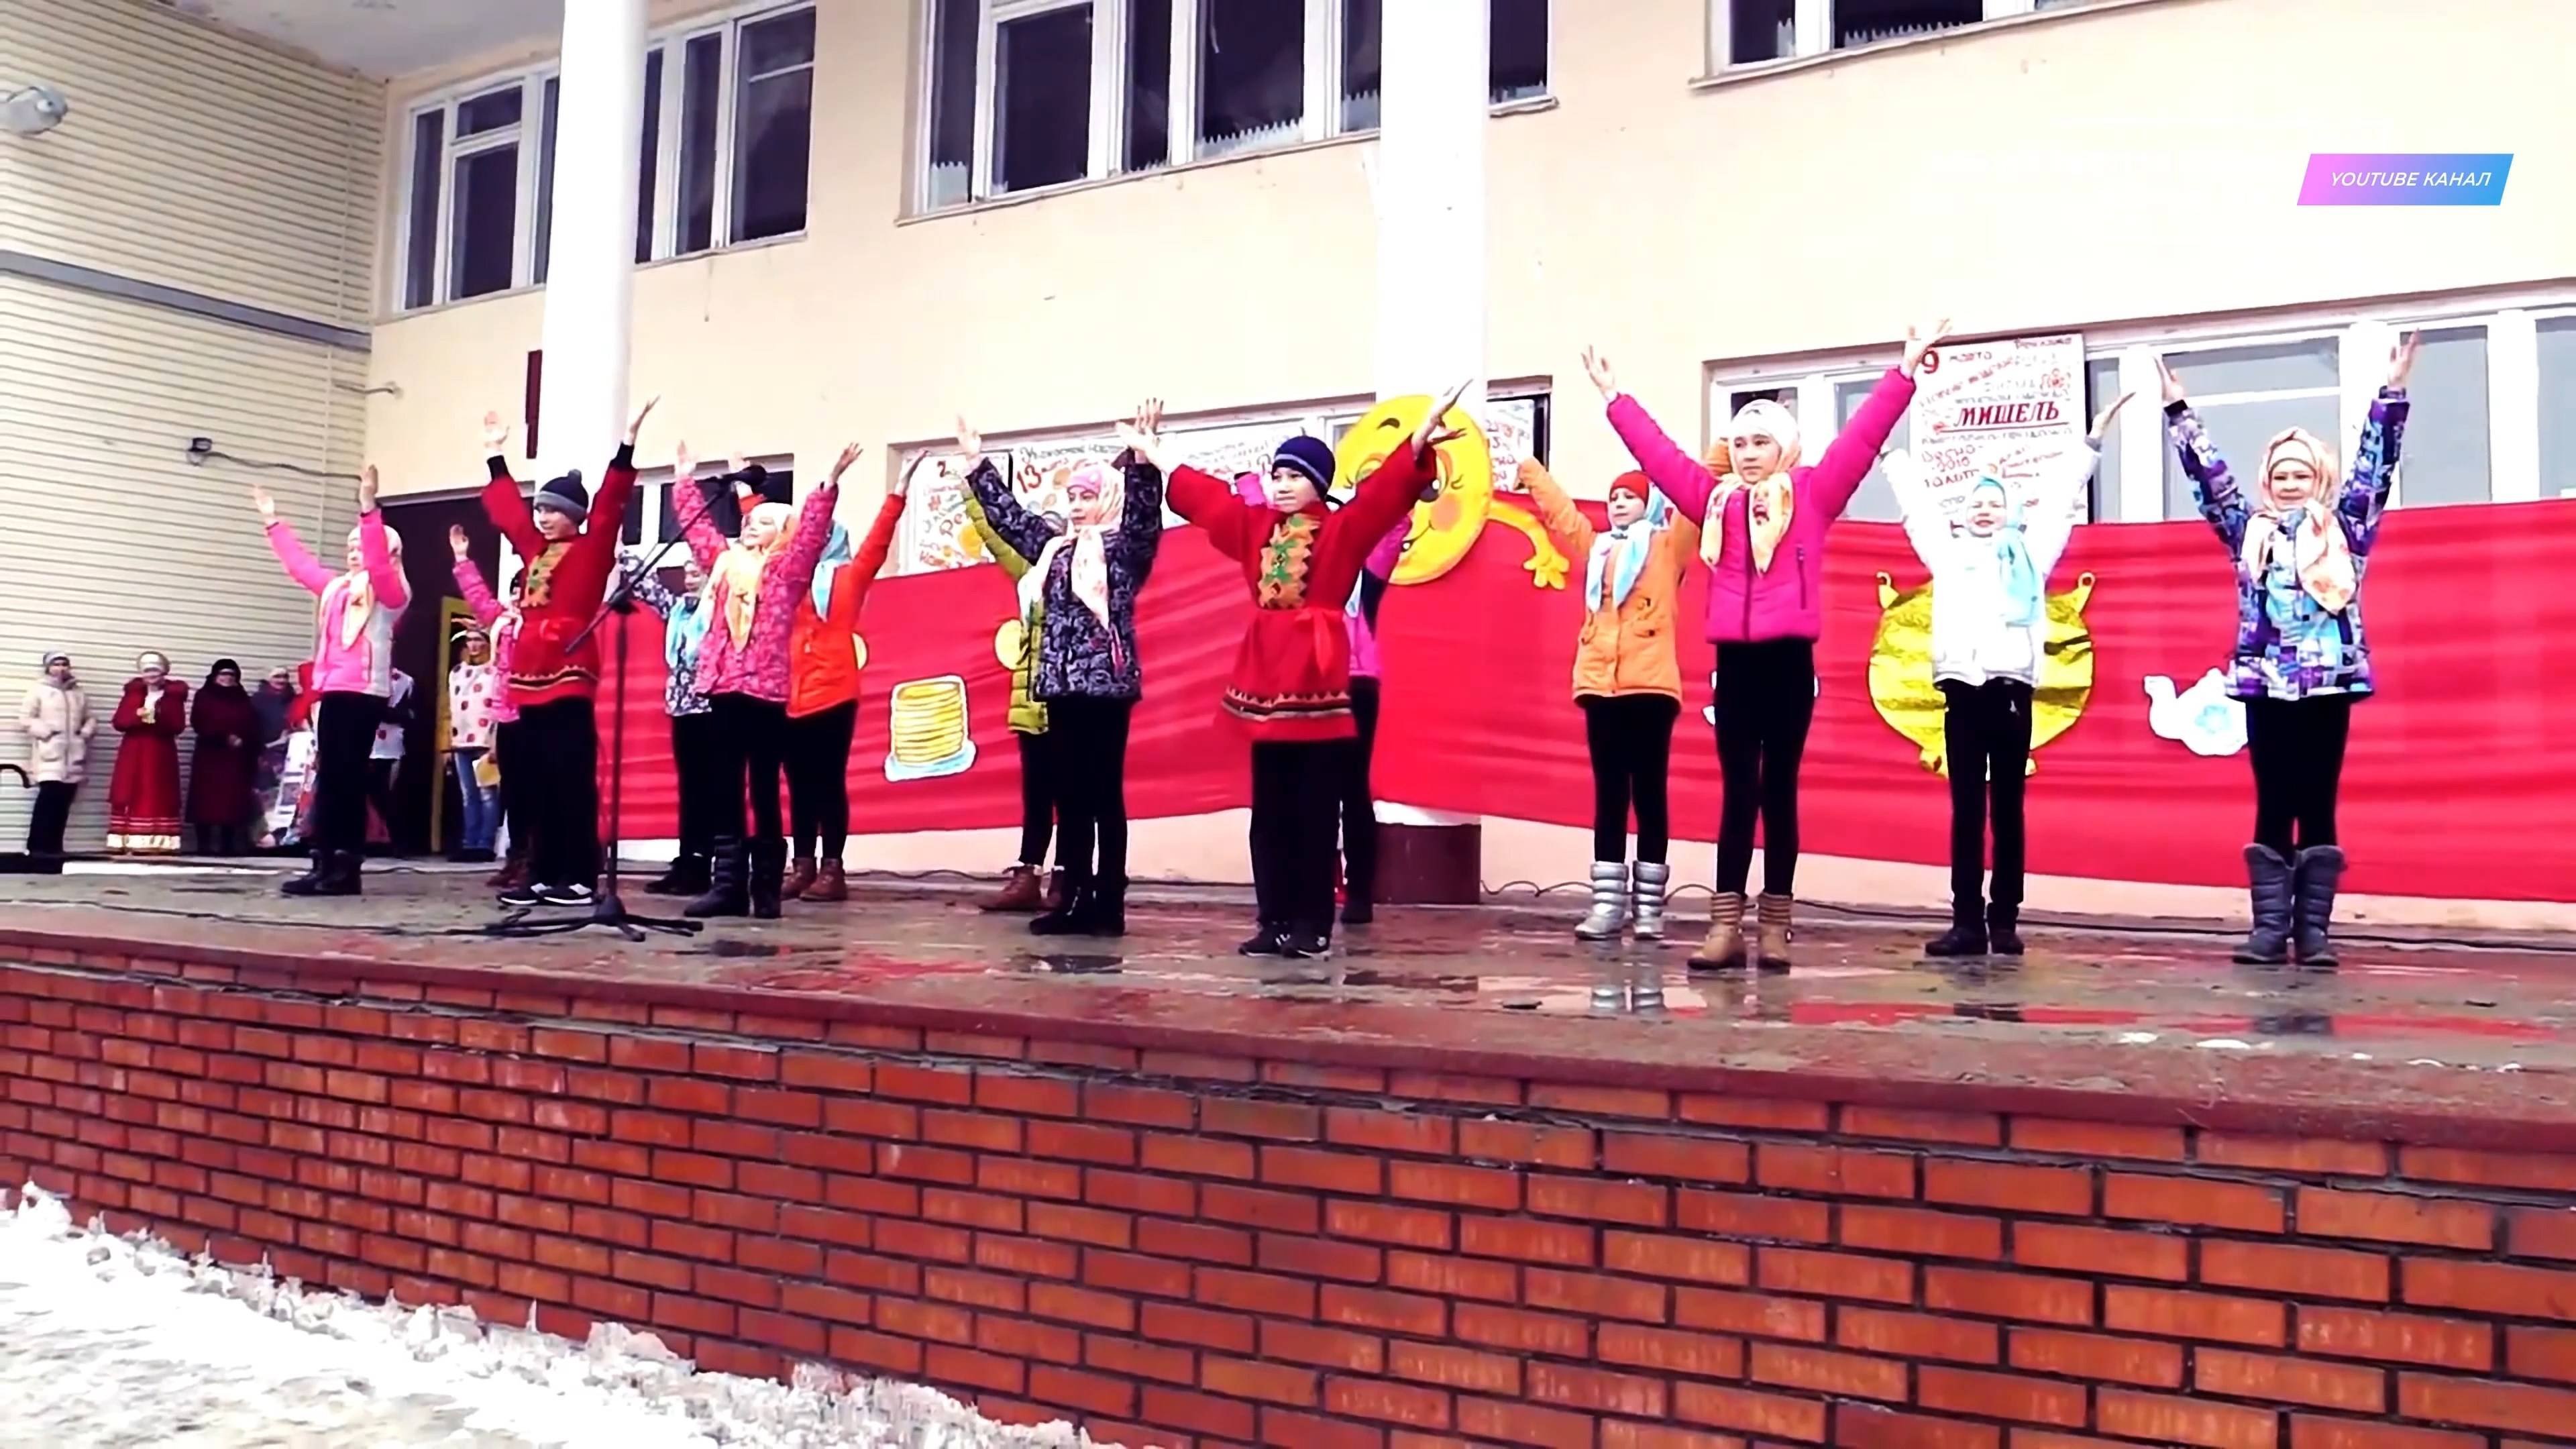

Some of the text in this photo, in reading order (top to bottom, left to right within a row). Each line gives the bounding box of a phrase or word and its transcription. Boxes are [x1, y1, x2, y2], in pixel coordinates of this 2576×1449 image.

[1921, 350, 1940, 374] 9
[1953, 400, 2060, 427] МИШЕЛЬ
[1016, 464, 1042, 494] 13
